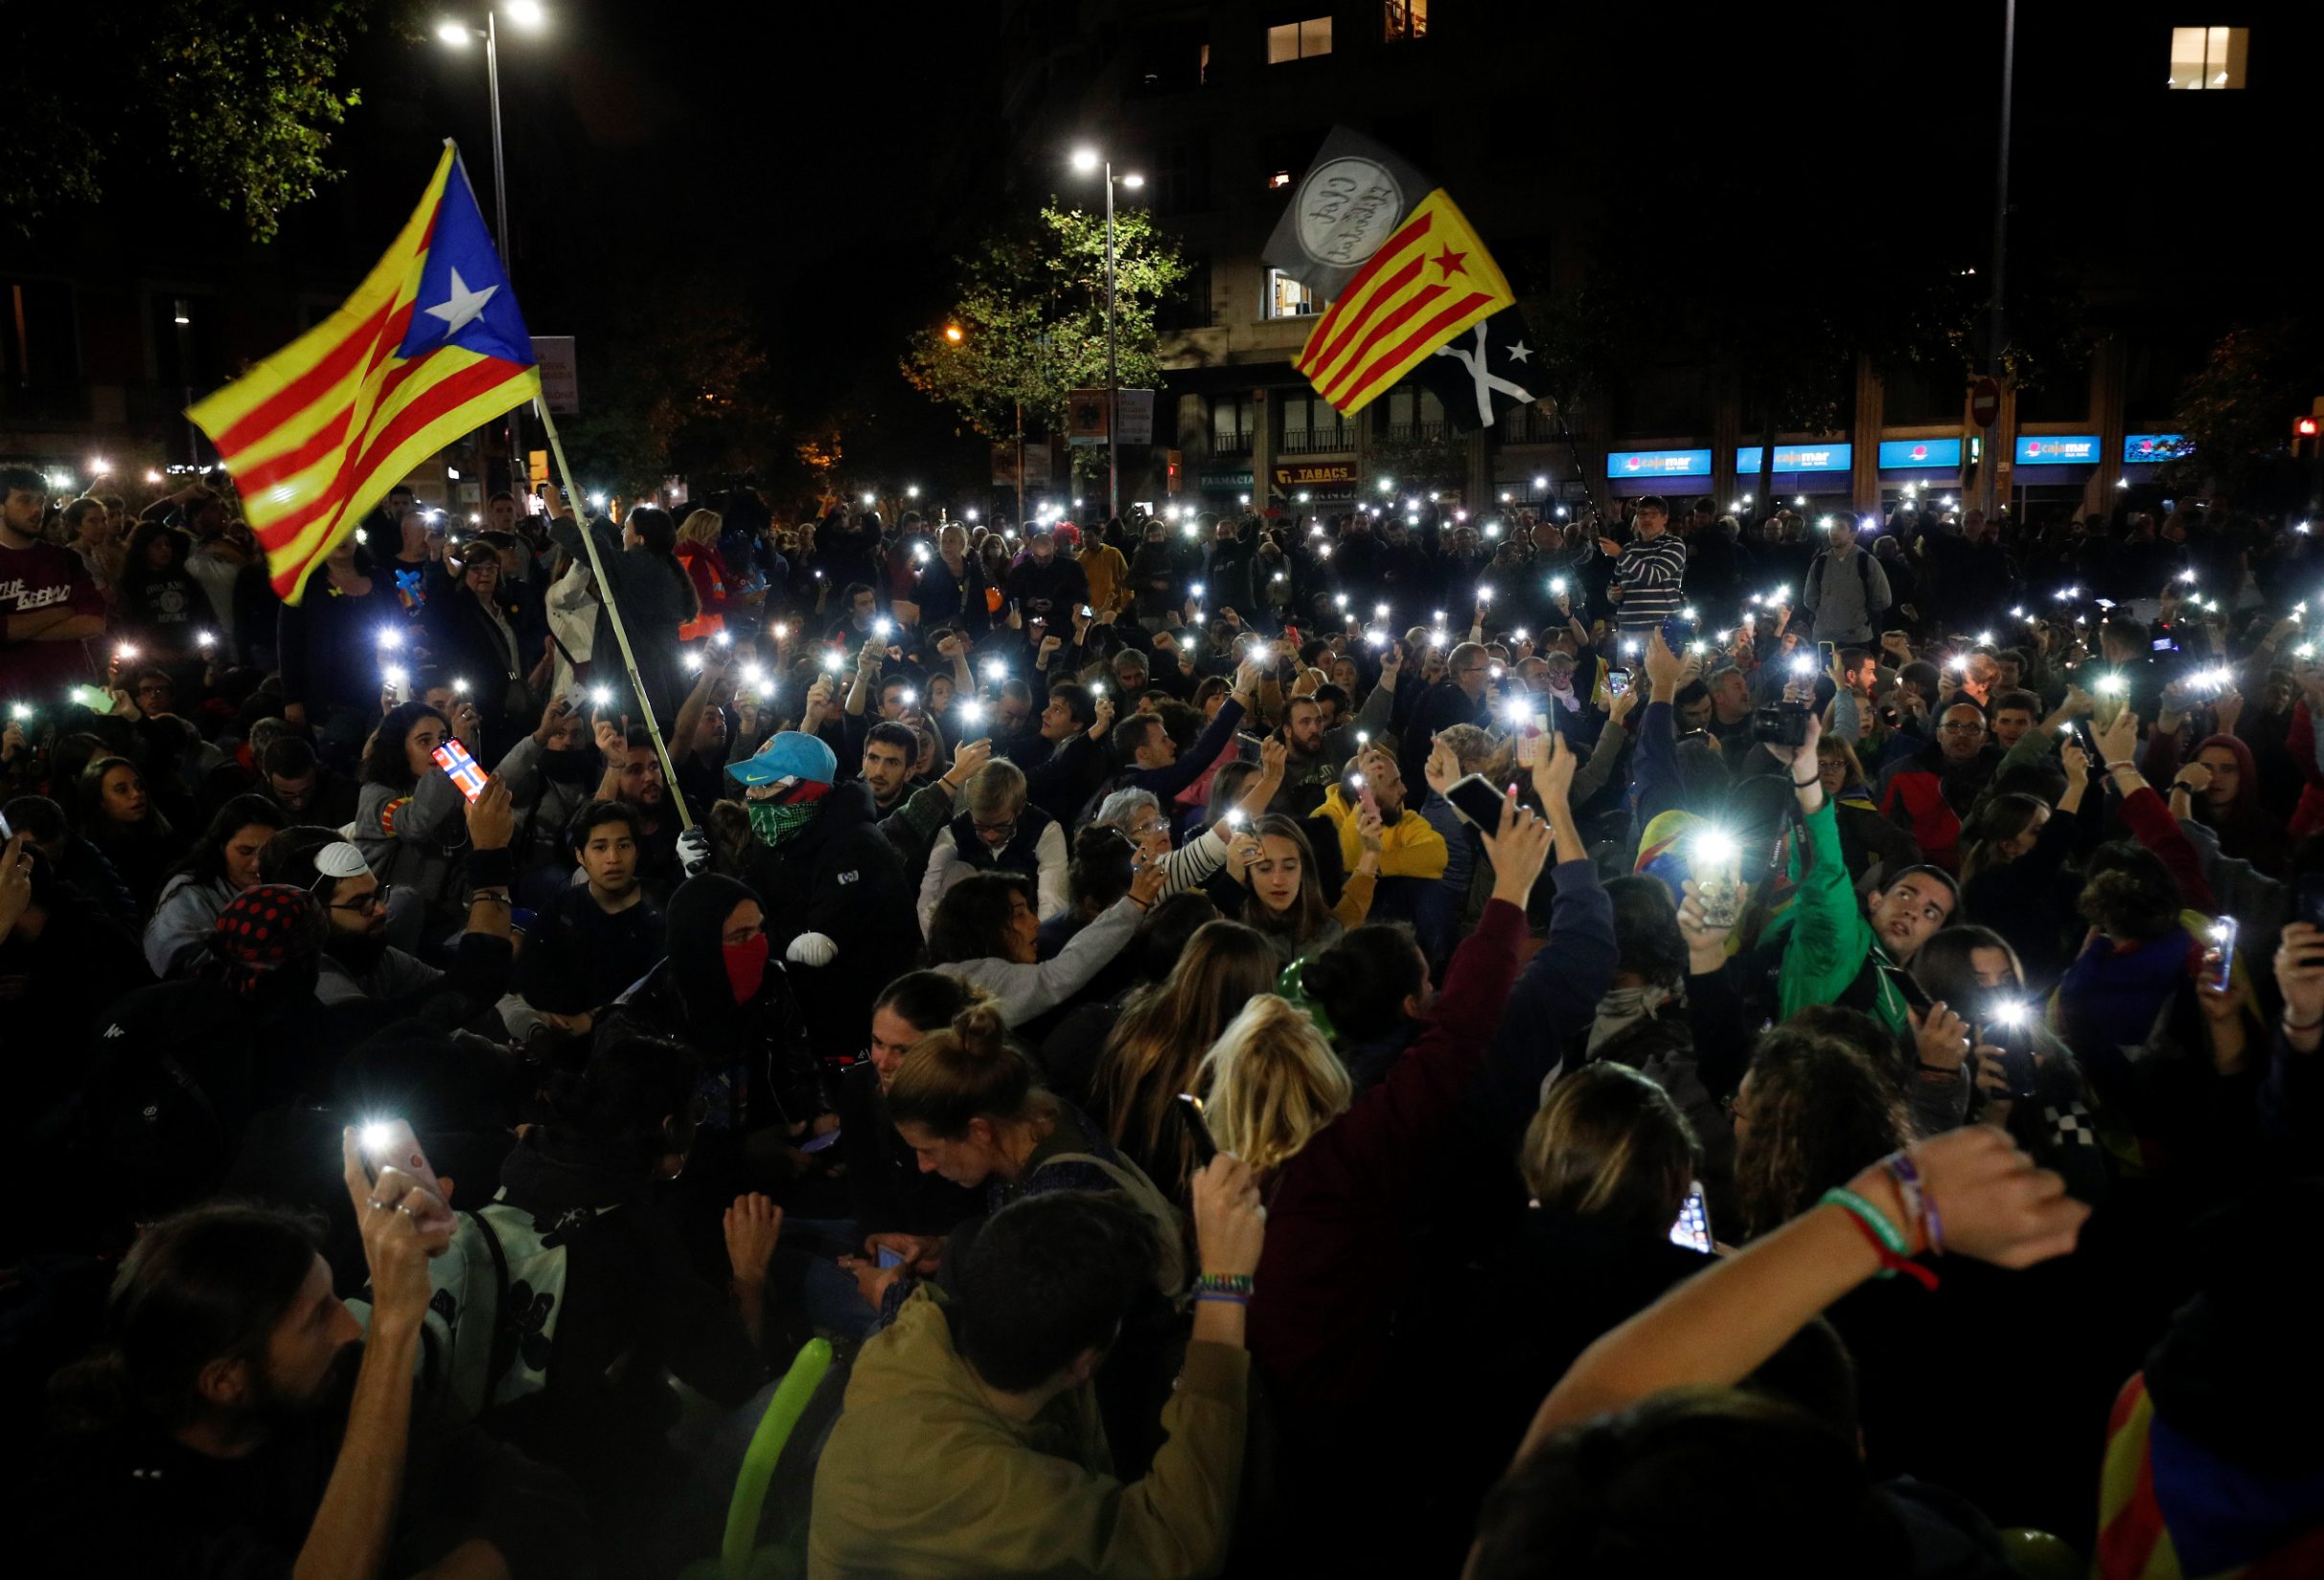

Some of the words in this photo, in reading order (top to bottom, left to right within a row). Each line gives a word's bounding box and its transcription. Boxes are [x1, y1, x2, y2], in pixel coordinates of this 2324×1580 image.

[2041, 441, 2091, 456] cajamar
[1642, 456, 1691, 469] cajamar
[1776, 450, 1829, 466] cajamar
[1201, 474, 1254, 486] FARMACIA
[1299, 467, 1348, 480] TABACS
[1770, 839, 1783, 868] Canon
